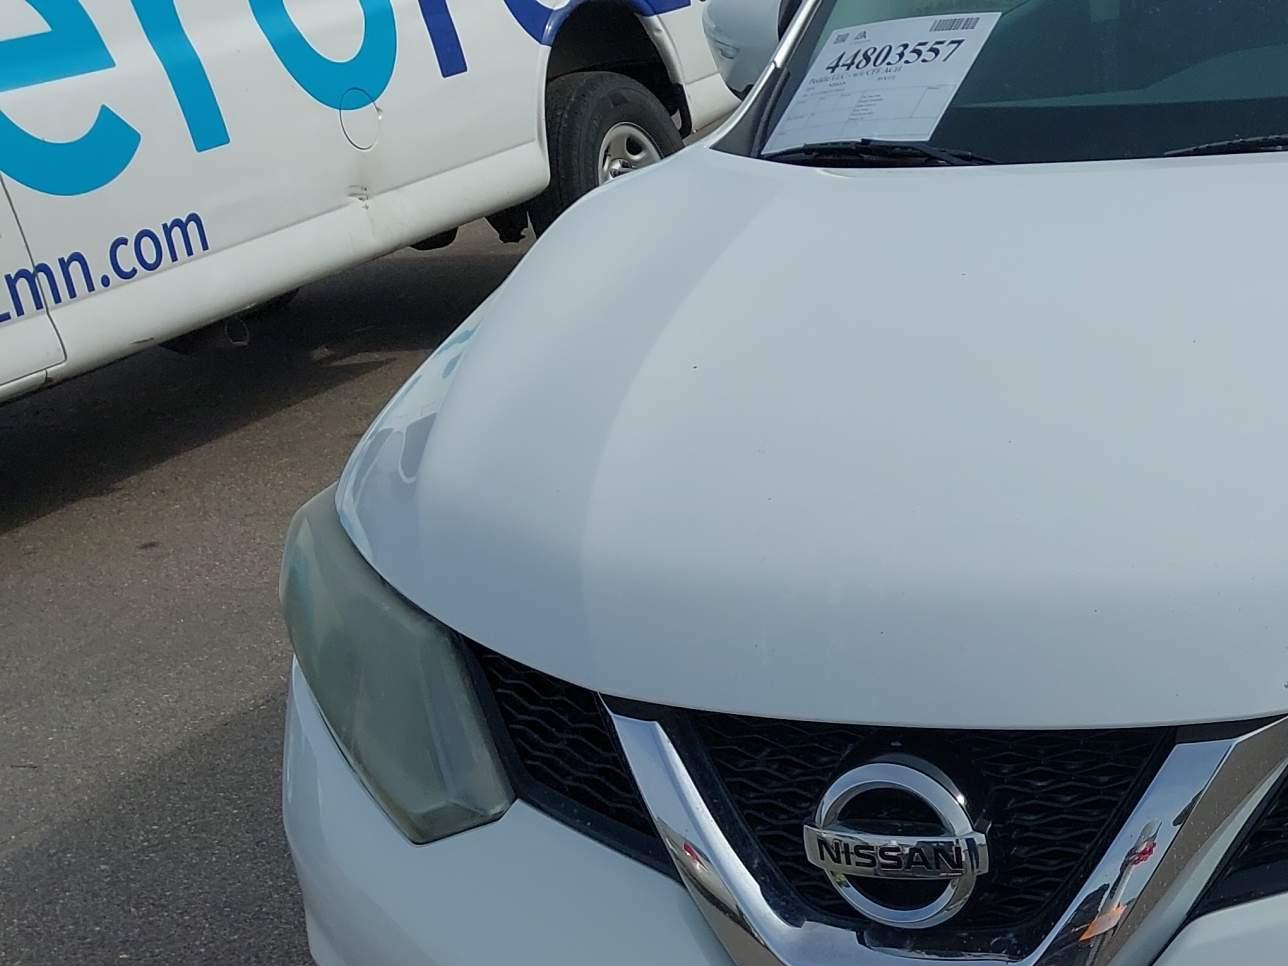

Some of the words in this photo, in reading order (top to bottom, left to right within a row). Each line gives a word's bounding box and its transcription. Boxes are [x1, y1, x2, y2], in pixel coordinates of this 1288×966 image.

[825, 39, 966, 74] 44803557
[0, 212, 209, 323] mn.com
[816, 837, 966, 872] NISSAN
